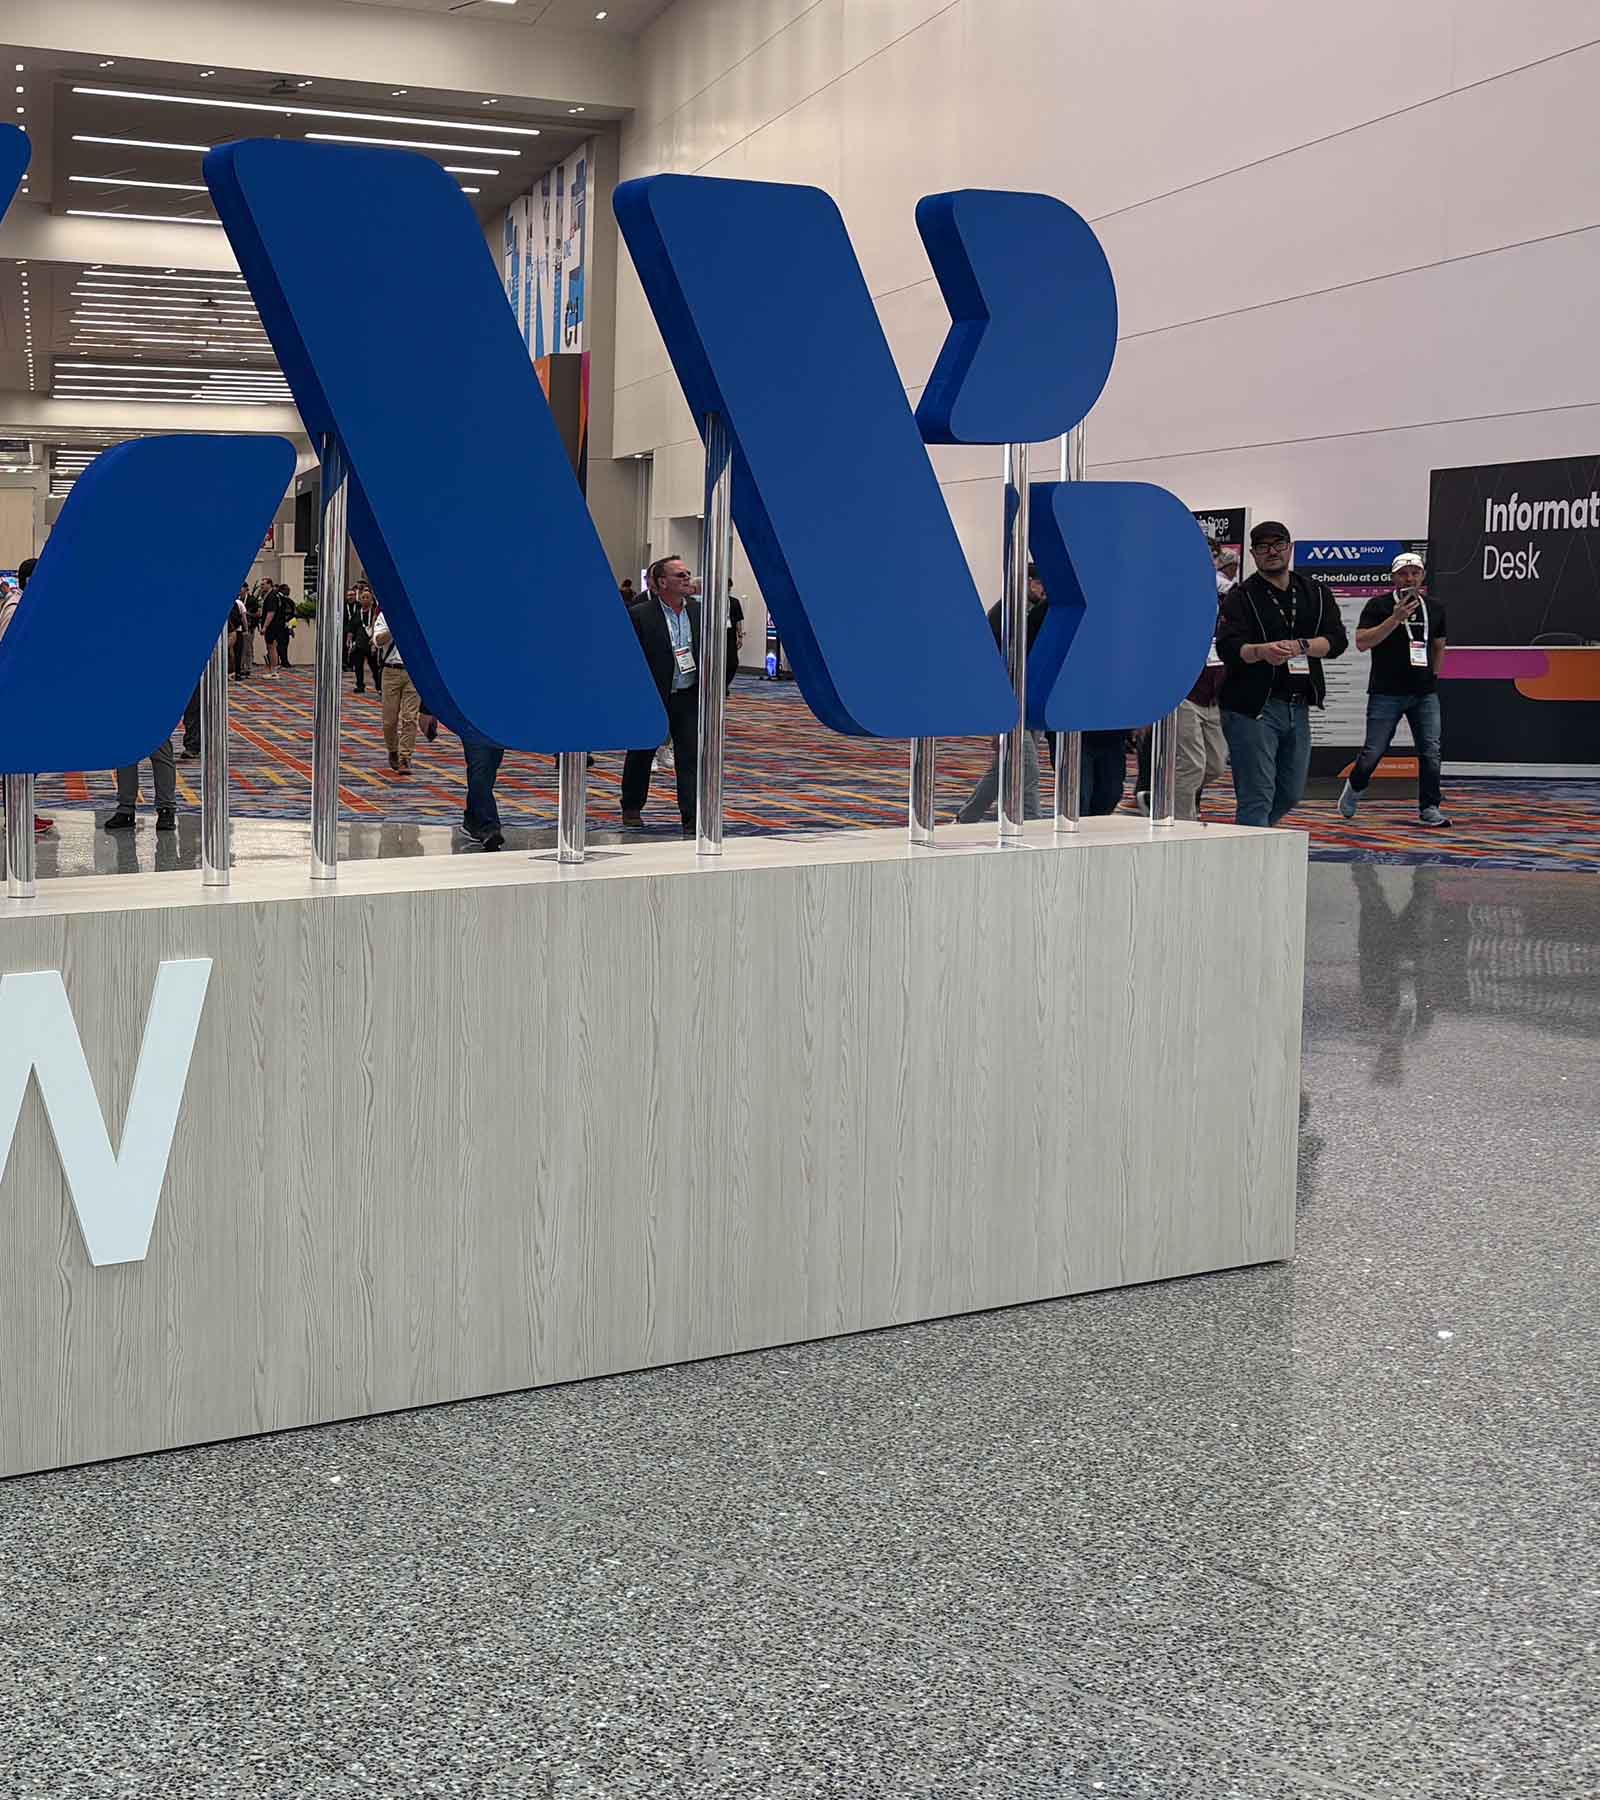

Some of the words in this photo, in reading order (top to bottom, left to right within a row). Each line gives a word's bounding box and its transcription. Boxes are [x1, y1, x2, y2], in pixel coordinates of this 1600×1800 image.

[1484, 491, 1600, 532] Informat
[1360, 546, 1385, 554] SHOW
[1483, 542, 1541, 580] Desk
[1311, 573, 1359, 583] Schedule
